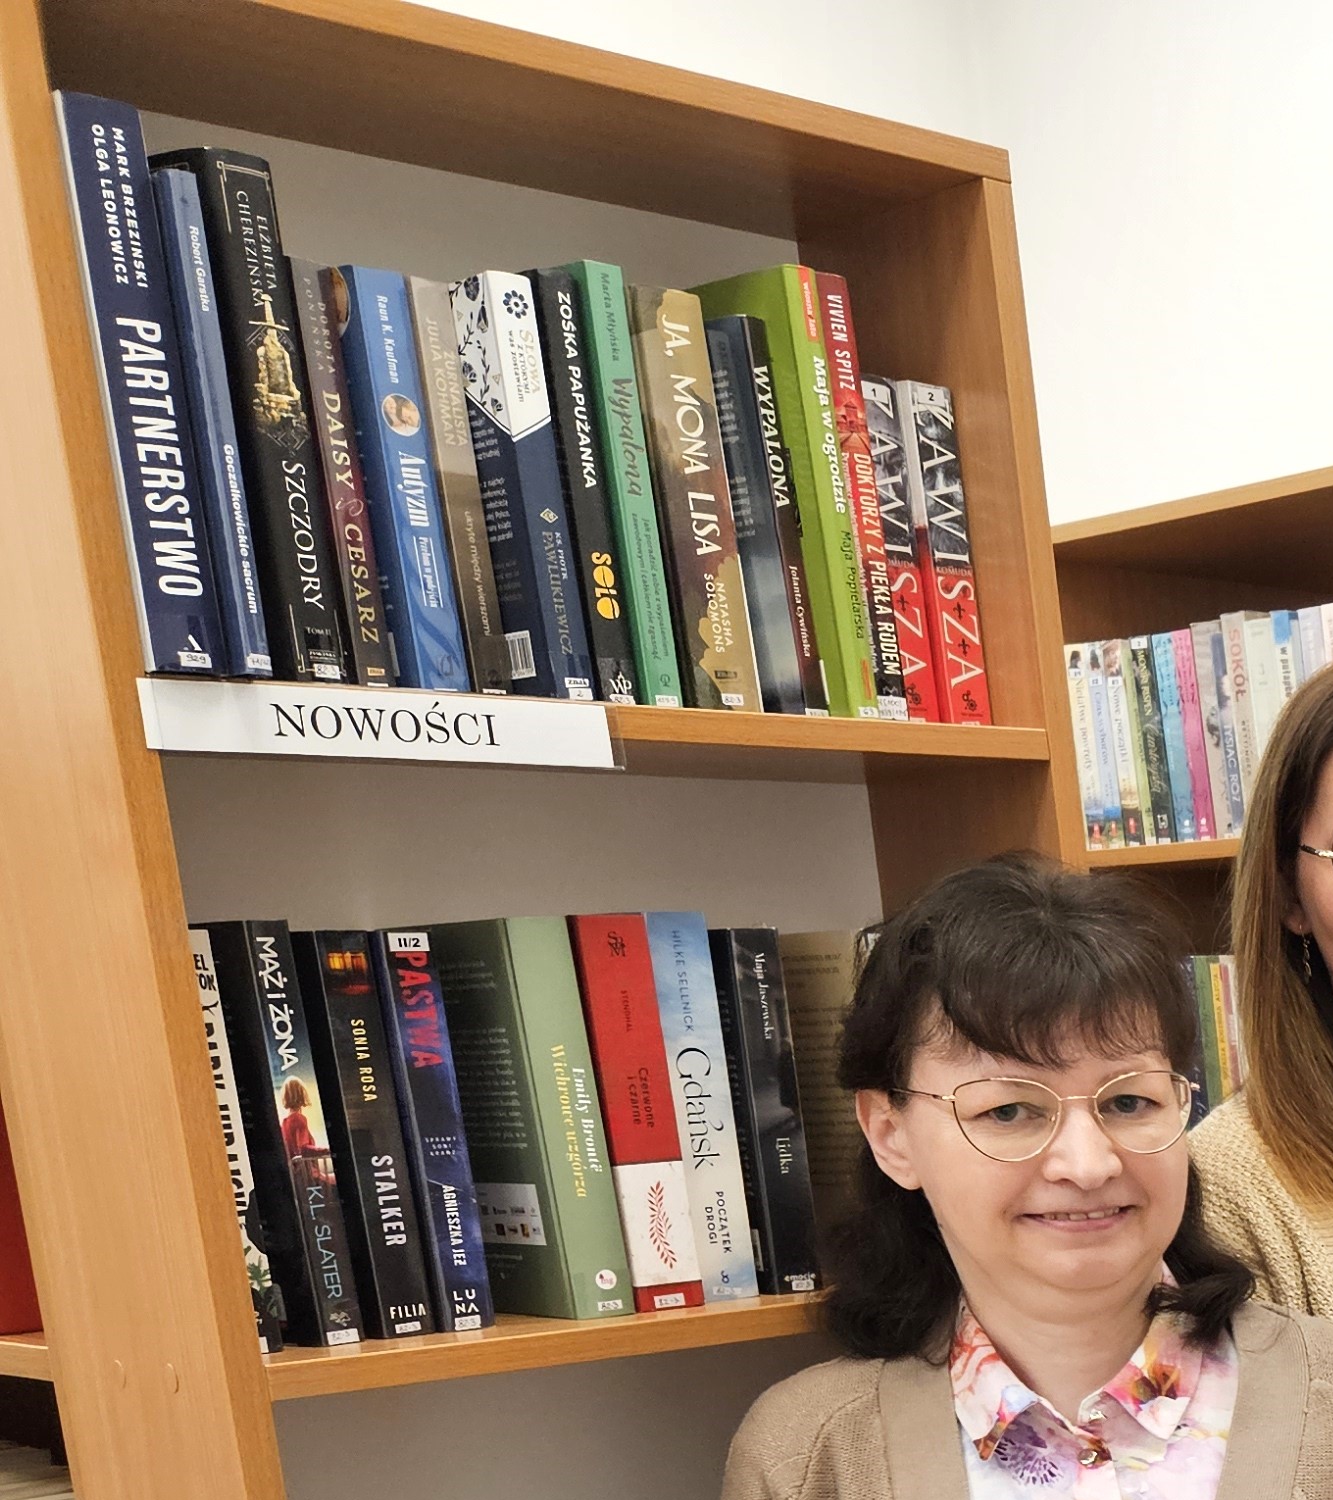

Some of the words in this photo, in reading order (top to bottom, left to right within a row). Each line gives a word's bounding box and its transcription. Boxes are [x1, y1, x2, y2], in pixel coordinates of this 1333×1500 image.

[111, 126, 132, 179] MARK
[91, 123, 108, 172] OLGA
[100, 178, 129, 286] LEONOWICZ
[120, 184, 148, 289] BRZEZINSKI
[256, 214, 278, 291] ELŻBIETA
[189, 225, 203, 266] Robert
[196, 266, 210, 312] Garstka
[317, 301, 338, 375] DOROTA
[376, 294, 389, 327] Raun
[383, 337, 400, 385] Kaufman
[425, 316, 443, 365] JULIA
[558, 290, 579, 359] ZOŚKA
[600, 271, 611, 310] Marta
[606, 311, 621, 363] Młyńska
[661, 313, 692, 357] JA,
[826, 294, 849, 343] VIVIEN
[511, 351, 525, 403] zostawiam
[812, 356, 830, 407] Maja
[834, 349, 856, 392] SPITZ
[927, 391, 936, 402] 2
[432, 364, 457, 447] KOHMAN
[568, 365, 597, 489] PAPUŻANKA
[670, 374, 710, 475] MONA
[753, 365, 790, 508] WYPALONA
[822, 410, 833, 427] w
[115, 317, 204, 597] PARTNERSTWO
[821, 430, 846, 514] ogrodzie
[322, 390, 356, 491] DAISY
[344, 523, 379, 645] CESARZ
[396, 450, 430, 528] Autyzm
[853, 452, 883, 539] DOKTORZY
[282, 460, 325, 611] SZCZODRY
[464, 510, 477, 543] ukryte
[554, 531, 563, 548] KS.
[687, 491, 722, 556] LISA
[866, 543, 885, 557] Z
[241, 558, 259, 615] sacrum
[470, 544, 482, 584] między
[541, 531, 574, 656] PAWLUKIEWICZ
[558, 548, 569, 580] PIOTR
[839, 530, 852, 561] Maja
[848, 566, 864, 640] Popielarska
[868, 560, 893, 615] PIEKŁA
[935, 564, 973, 578] KOMUDA
[475, 583, 492, 638] wierszami
[704, 572, 726, 654] SOLOMONS
[716, 582, 734, 647] NATASHA
[788, 564, 803, 604] Jolanta
[796, 605, 811, 658] Cywińska
[876, 619, 902, 676] RODEM
[273, 701, 501, 748] NOWOŚCI
[255, 936, 288, 990] MĄŻ
[671, 930, 686, 966] HILKE
[753, 952, 766, 980] Maja
[395, 951, 443, 1069] PASTWA
[620, 989, 634, 1033] STENDHAL
[677, 971, 695, 1033] SELLNICK
[758, 982, 775, 1040] Jaszewska
[268, 1003, 299, 1072] ŻONA
[350, 1018, 371, 1062] SONIA
[359, 1065, 378, 1102] ROSA
[571, 1067, 595, 1114] Emily
[628, 1083, 642, 1126] czarne
[637, 1067, 655, 1129] Czerwone
[675, 1047, 724, 1171] Gdańsk
[550, 1043, 575, 1127] Wichrowe
[565, 1129, 588, 1198] wzgórza
[580, 1117, 603, 1174] Brontë
[775, 1137, 793, 1175] Lidka
[305, 1185, 327, 1220] K.L.
[371, 1154, 407, 1247] STALKER
[441, 1184, 463, 1247] AGNIESZKA
[704, 1206, 719, 1245] DROGI
[715, 1191, 733, 1254] POCZĄTEK
[314, 1223, 343, 1300] SLATER
